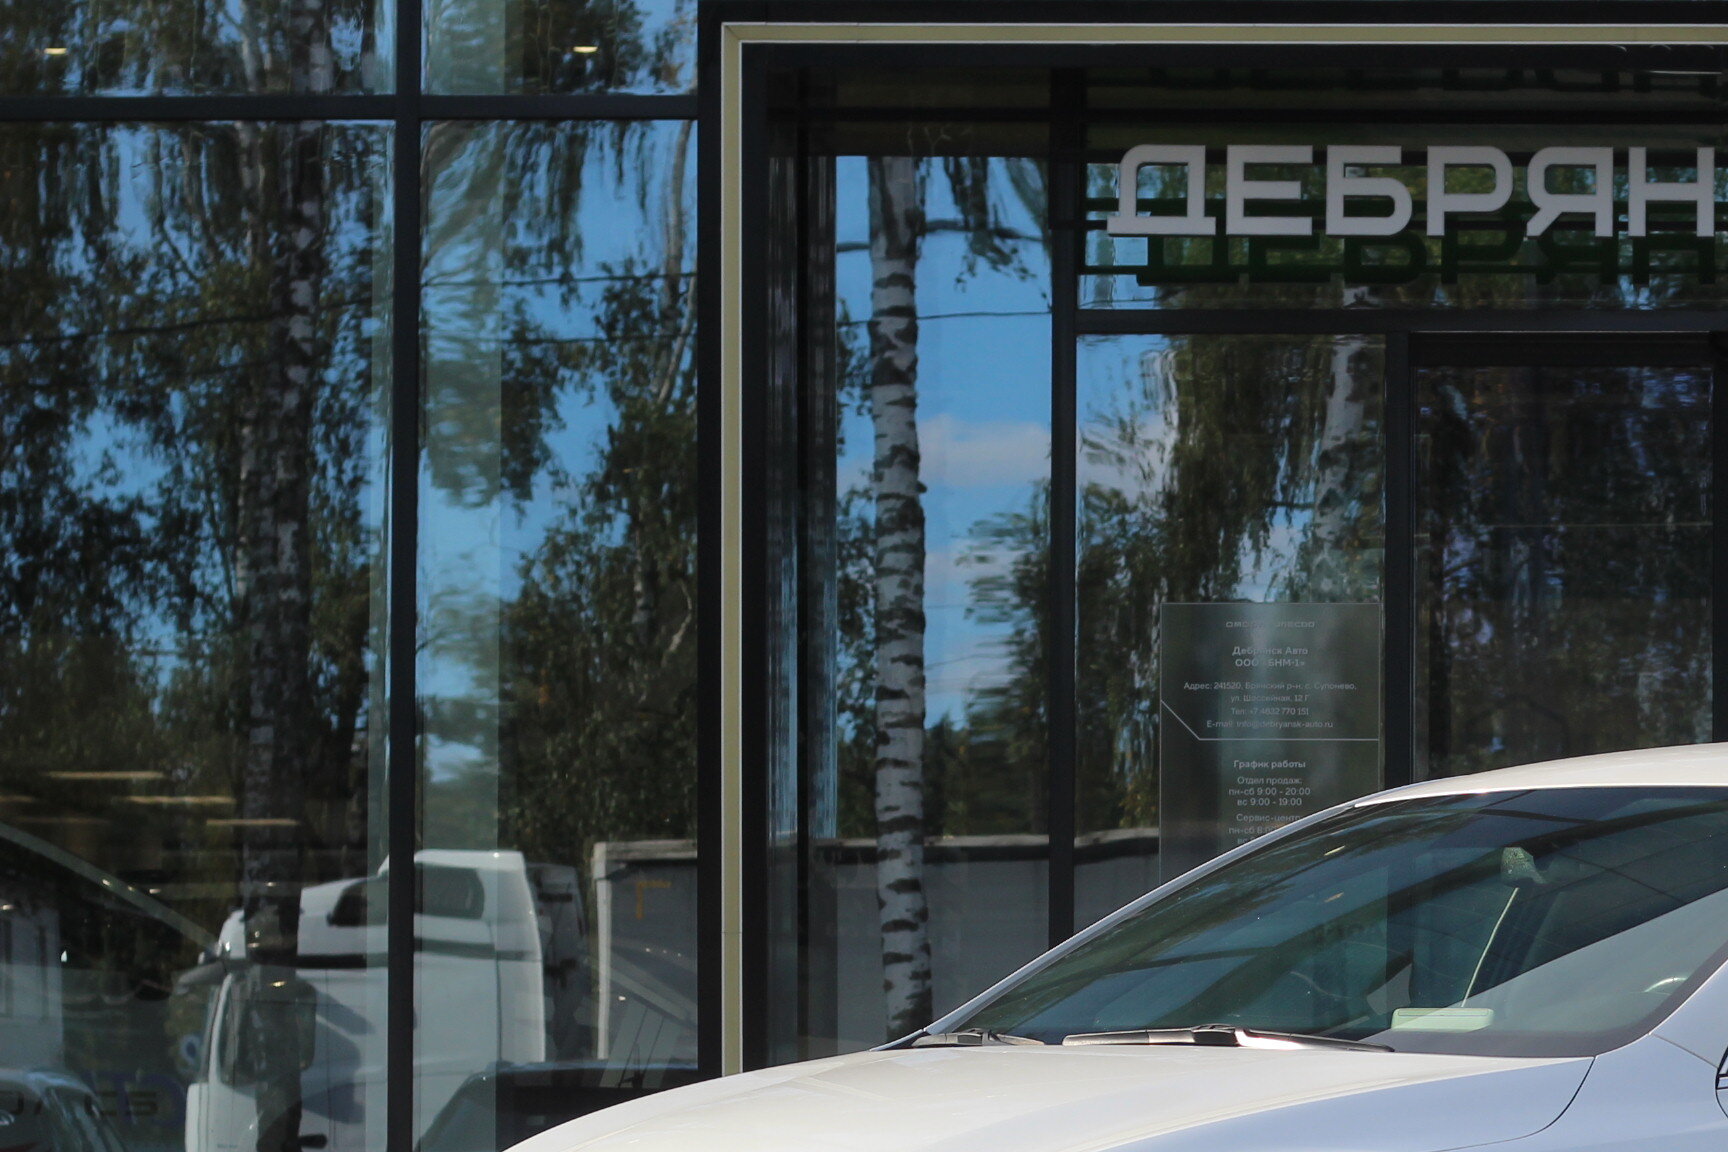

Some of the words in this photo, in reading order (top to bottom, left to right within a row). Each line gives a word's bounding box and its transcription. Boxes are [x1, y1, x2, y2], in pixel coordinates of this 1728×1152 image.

[1233, 760, 1270, 770] График
[1271, 760, 1306, 770] работы
[1237, 776, 1264, 785] Отдел
[1228, 787, 1255, 796] пн-сб
